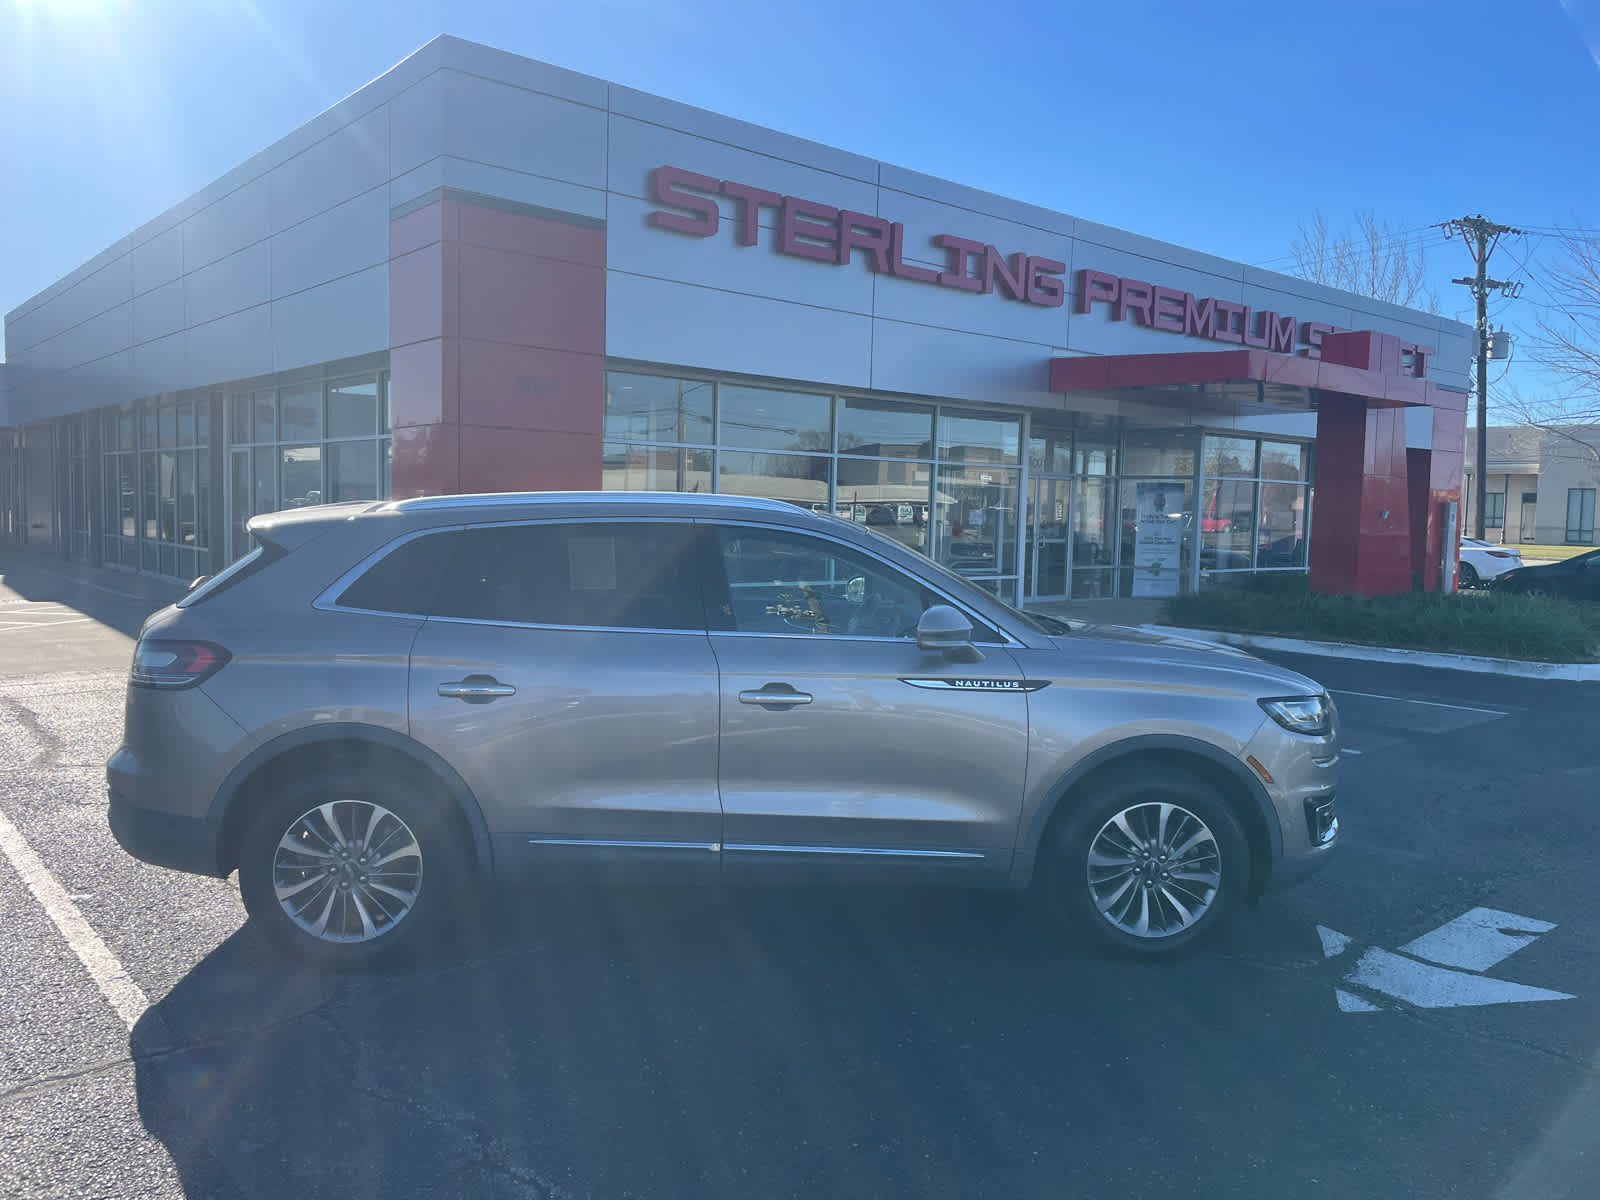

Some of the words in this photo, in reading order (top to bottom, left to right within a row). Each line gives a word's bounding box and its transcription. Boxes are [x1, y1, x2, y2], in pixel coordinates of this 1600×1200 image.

[647, 165, 1066, 308] STERLING
[1077, 268, 1297, 353] PREMIUM
[954, 679, 1020, 688] NAUTILUS
